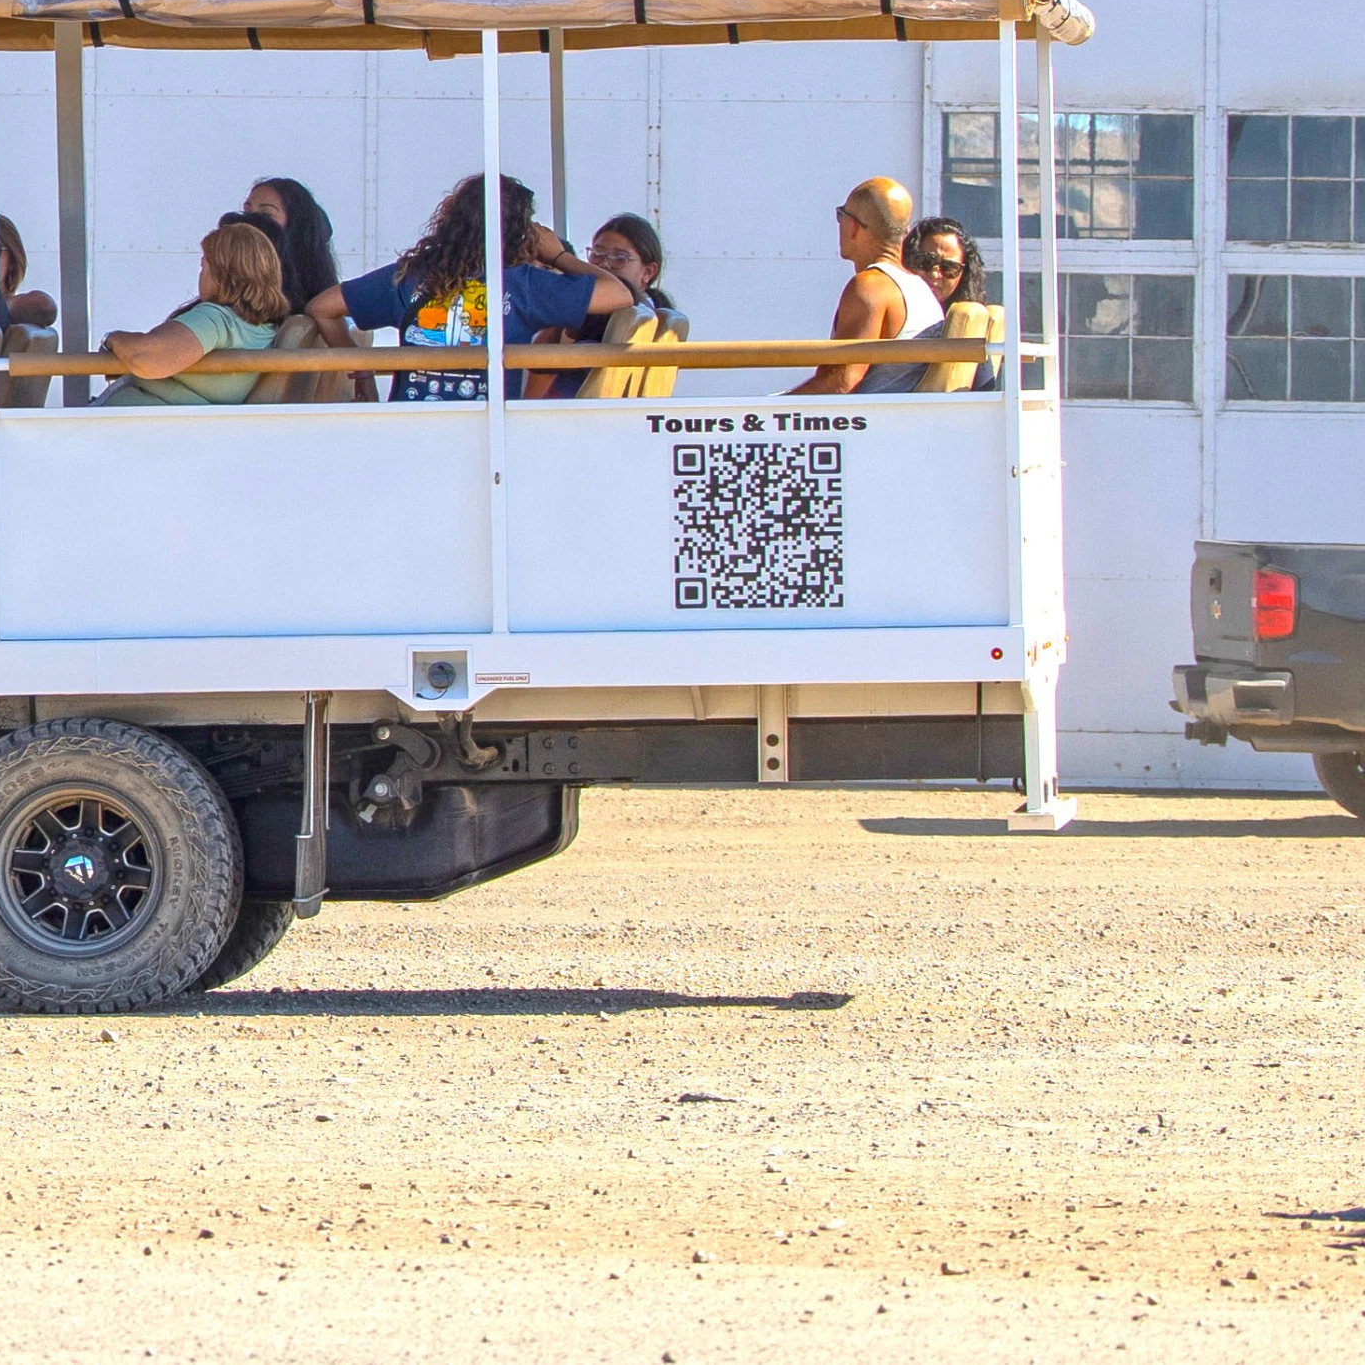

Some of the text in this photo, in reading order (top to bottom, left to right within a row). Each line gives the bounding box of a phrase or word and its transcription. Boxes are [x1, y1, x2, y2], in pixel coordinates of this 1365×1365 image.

[646, 412, 868, 433] Tours & Times
